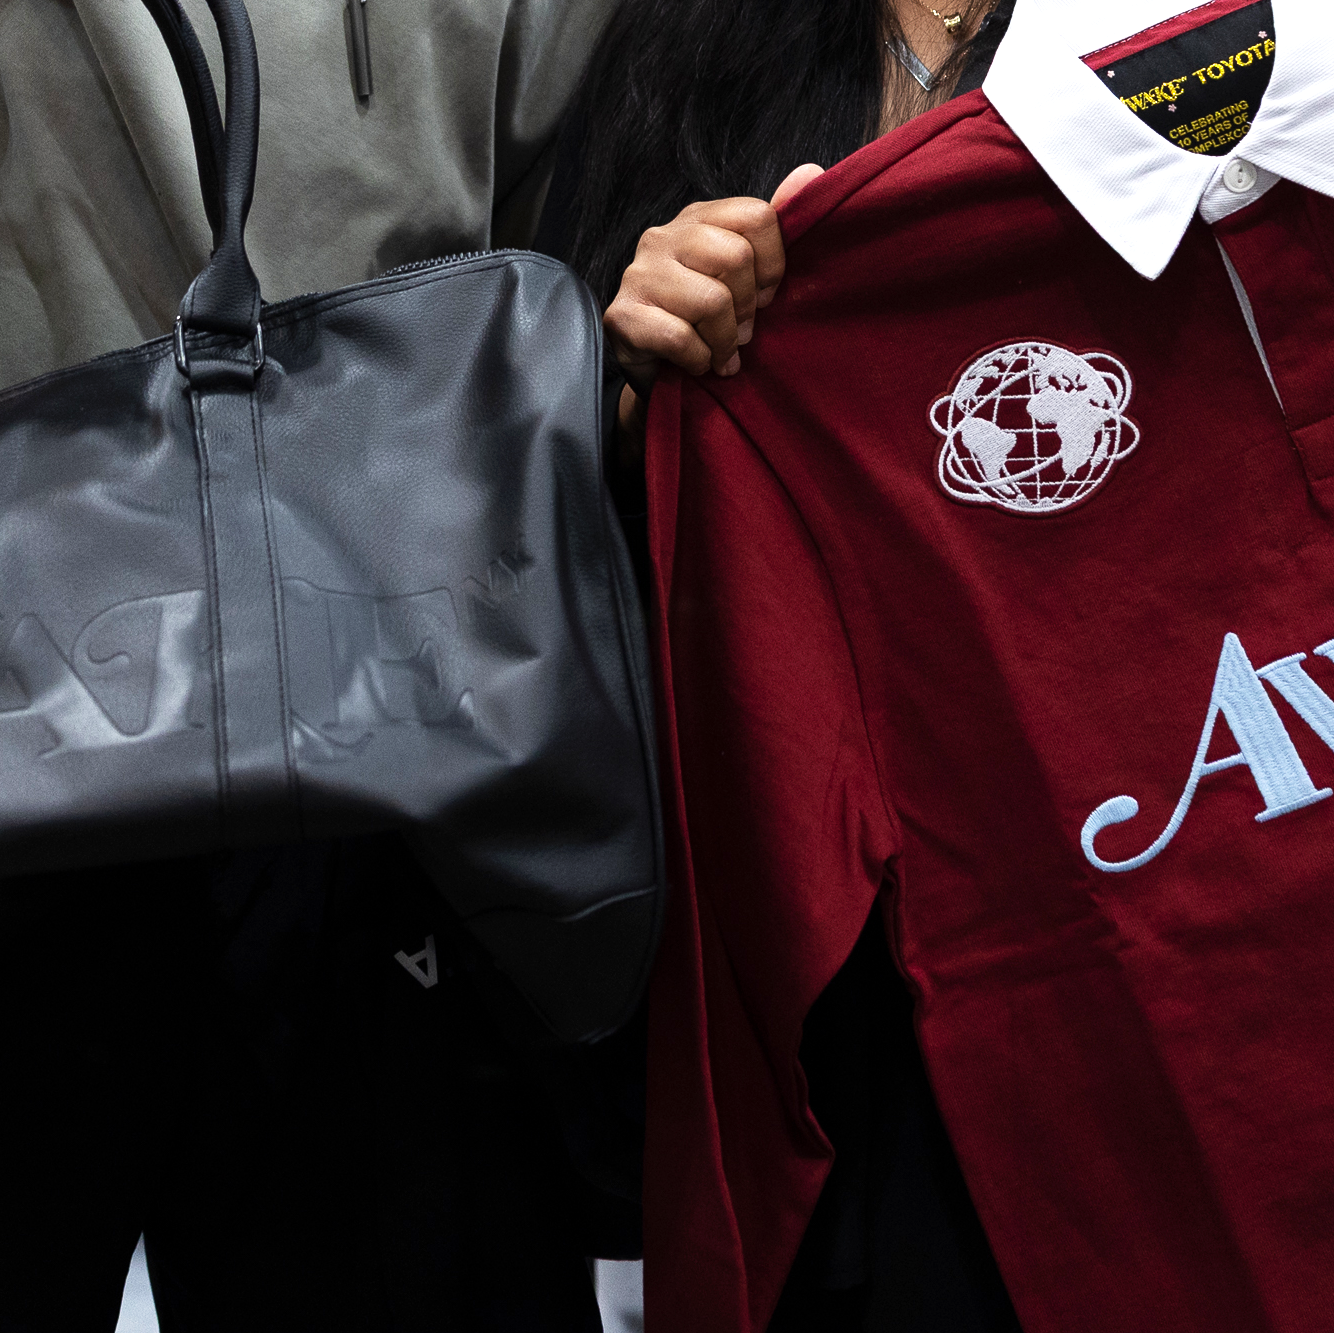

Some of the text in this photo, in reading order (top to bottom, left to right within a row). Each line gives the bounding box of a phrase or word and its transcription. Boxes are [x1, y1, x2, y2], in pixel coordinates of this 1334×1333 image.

[1192, 38, 1276, 84] TOYOTA
[1169, 100, 1249, 139] CELEBRATING
[1177, 112, 1249, 148] 10 YEARS OF
